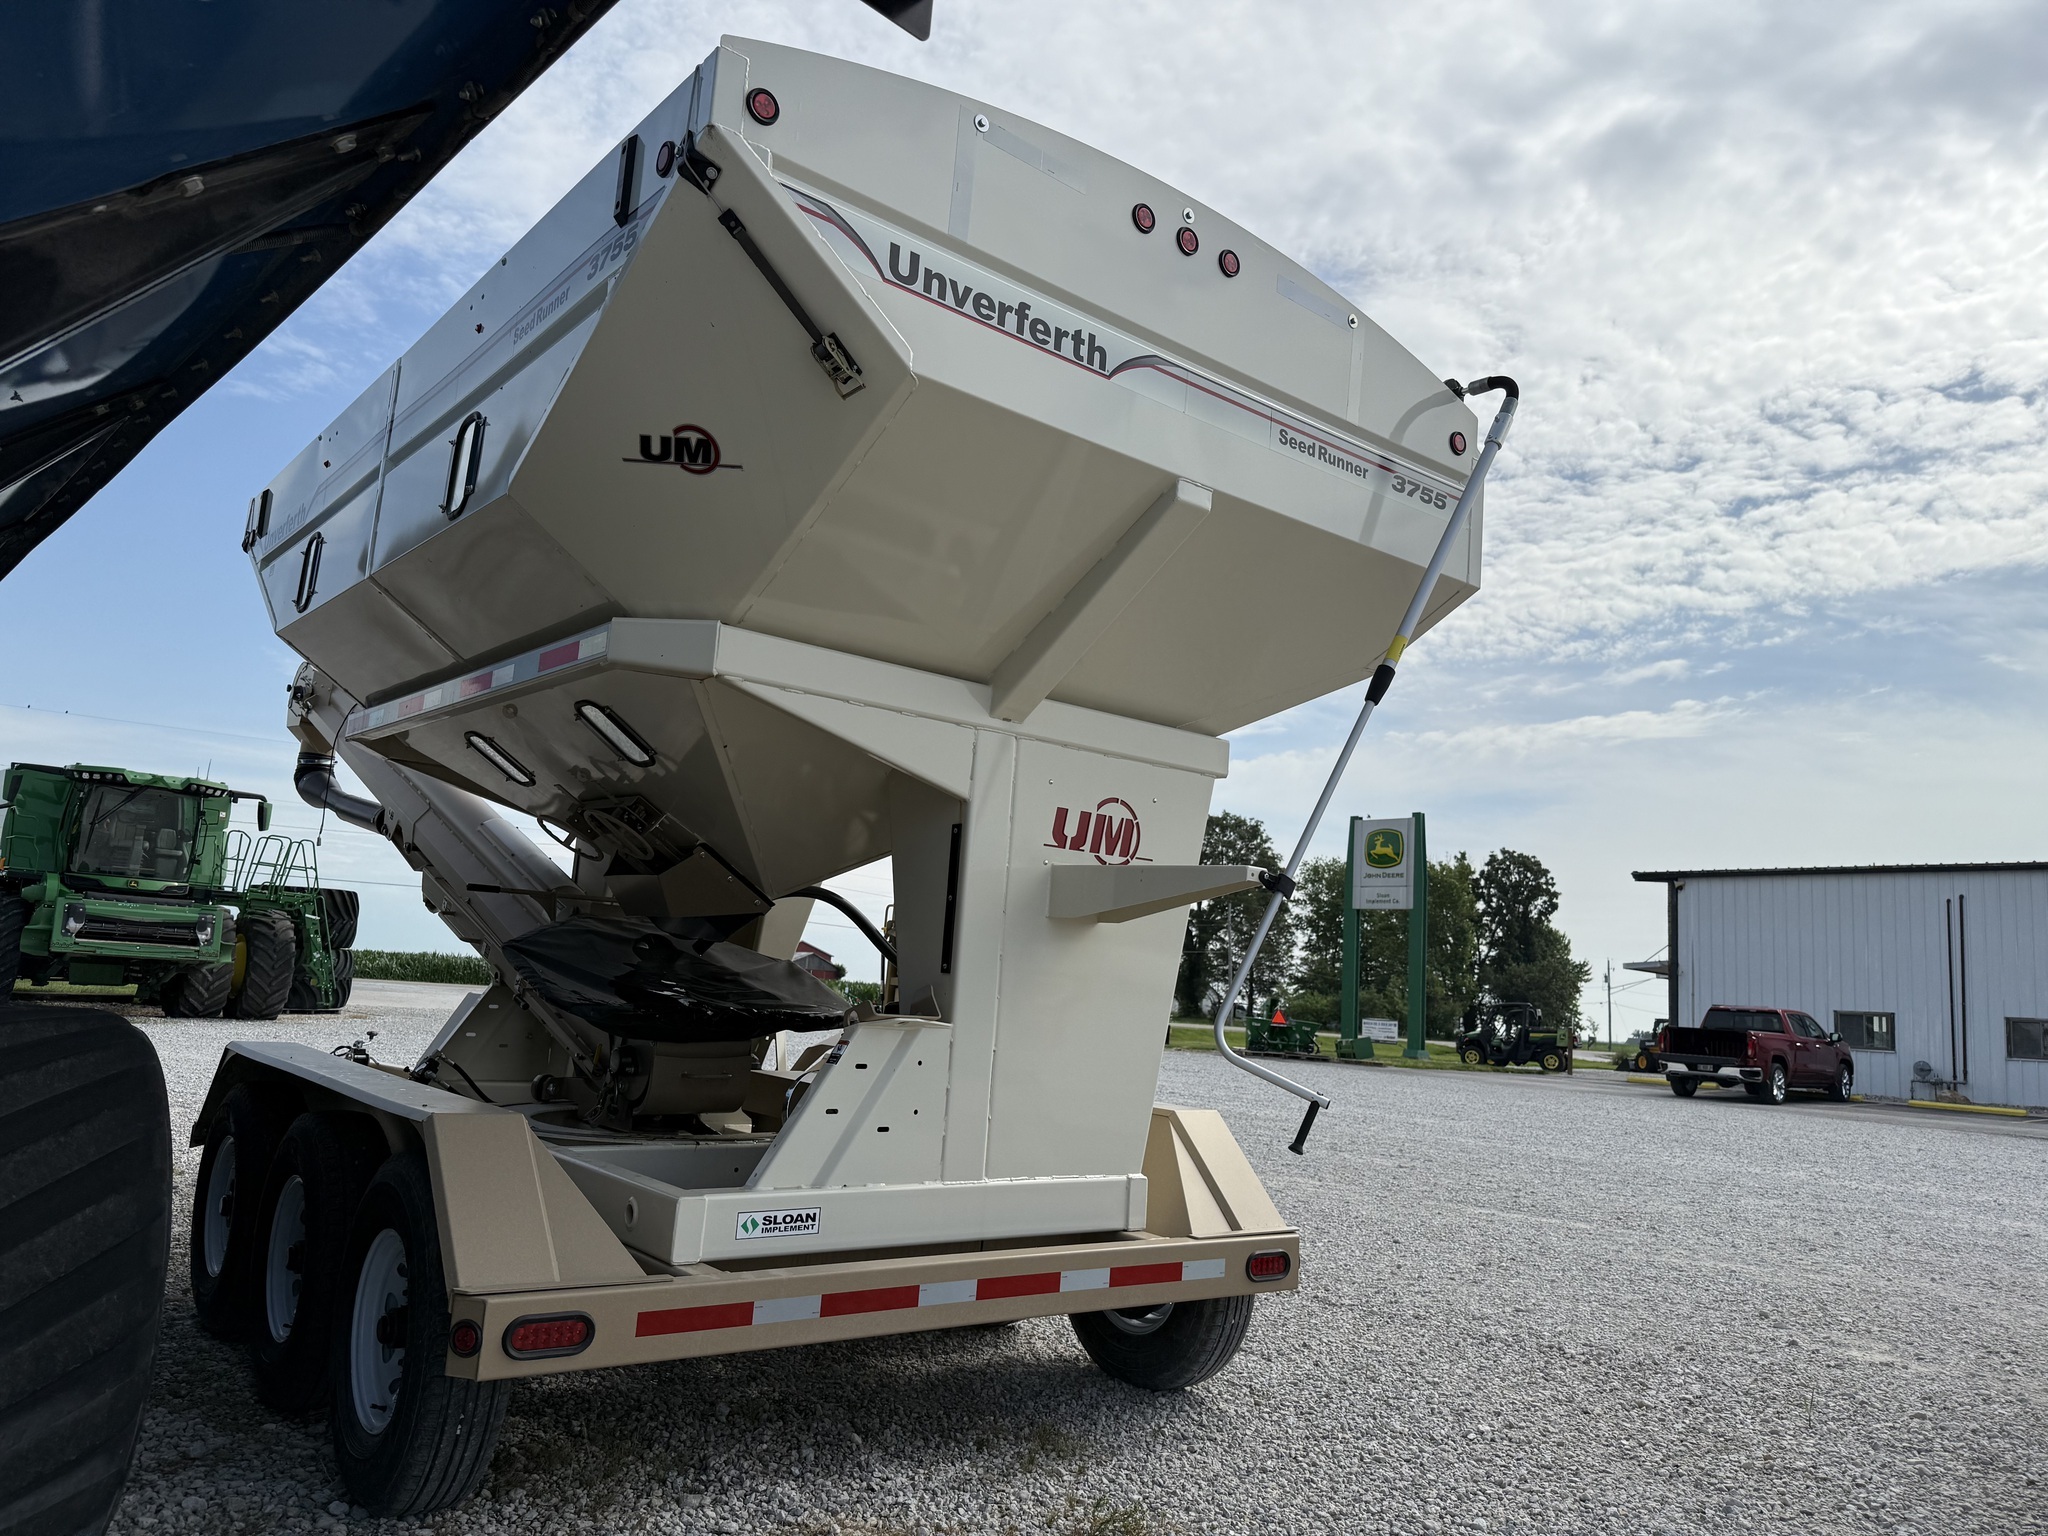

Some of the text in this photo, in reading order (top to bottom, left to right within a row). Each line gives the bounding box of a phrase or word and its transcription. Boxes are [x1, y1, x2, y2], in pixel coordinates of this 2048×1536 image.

[587, 222, 640, 281] 3755
[513, 286, 571, 346] Seed Runner
[888, 241, 1108, 372] Unverferth
[639, 433, 713, 465] UM
[1278, 428, 1369, 479] Seed Runner
[1391, 474, 1448, 511] 3755
[264, 503, 307, 552] Unverferth
[1052, 806, 1135, 858] UM
[761, 1212, 817, 1226] SLOAN
[761, 1223, 816, 1234] IMPLEMENT
